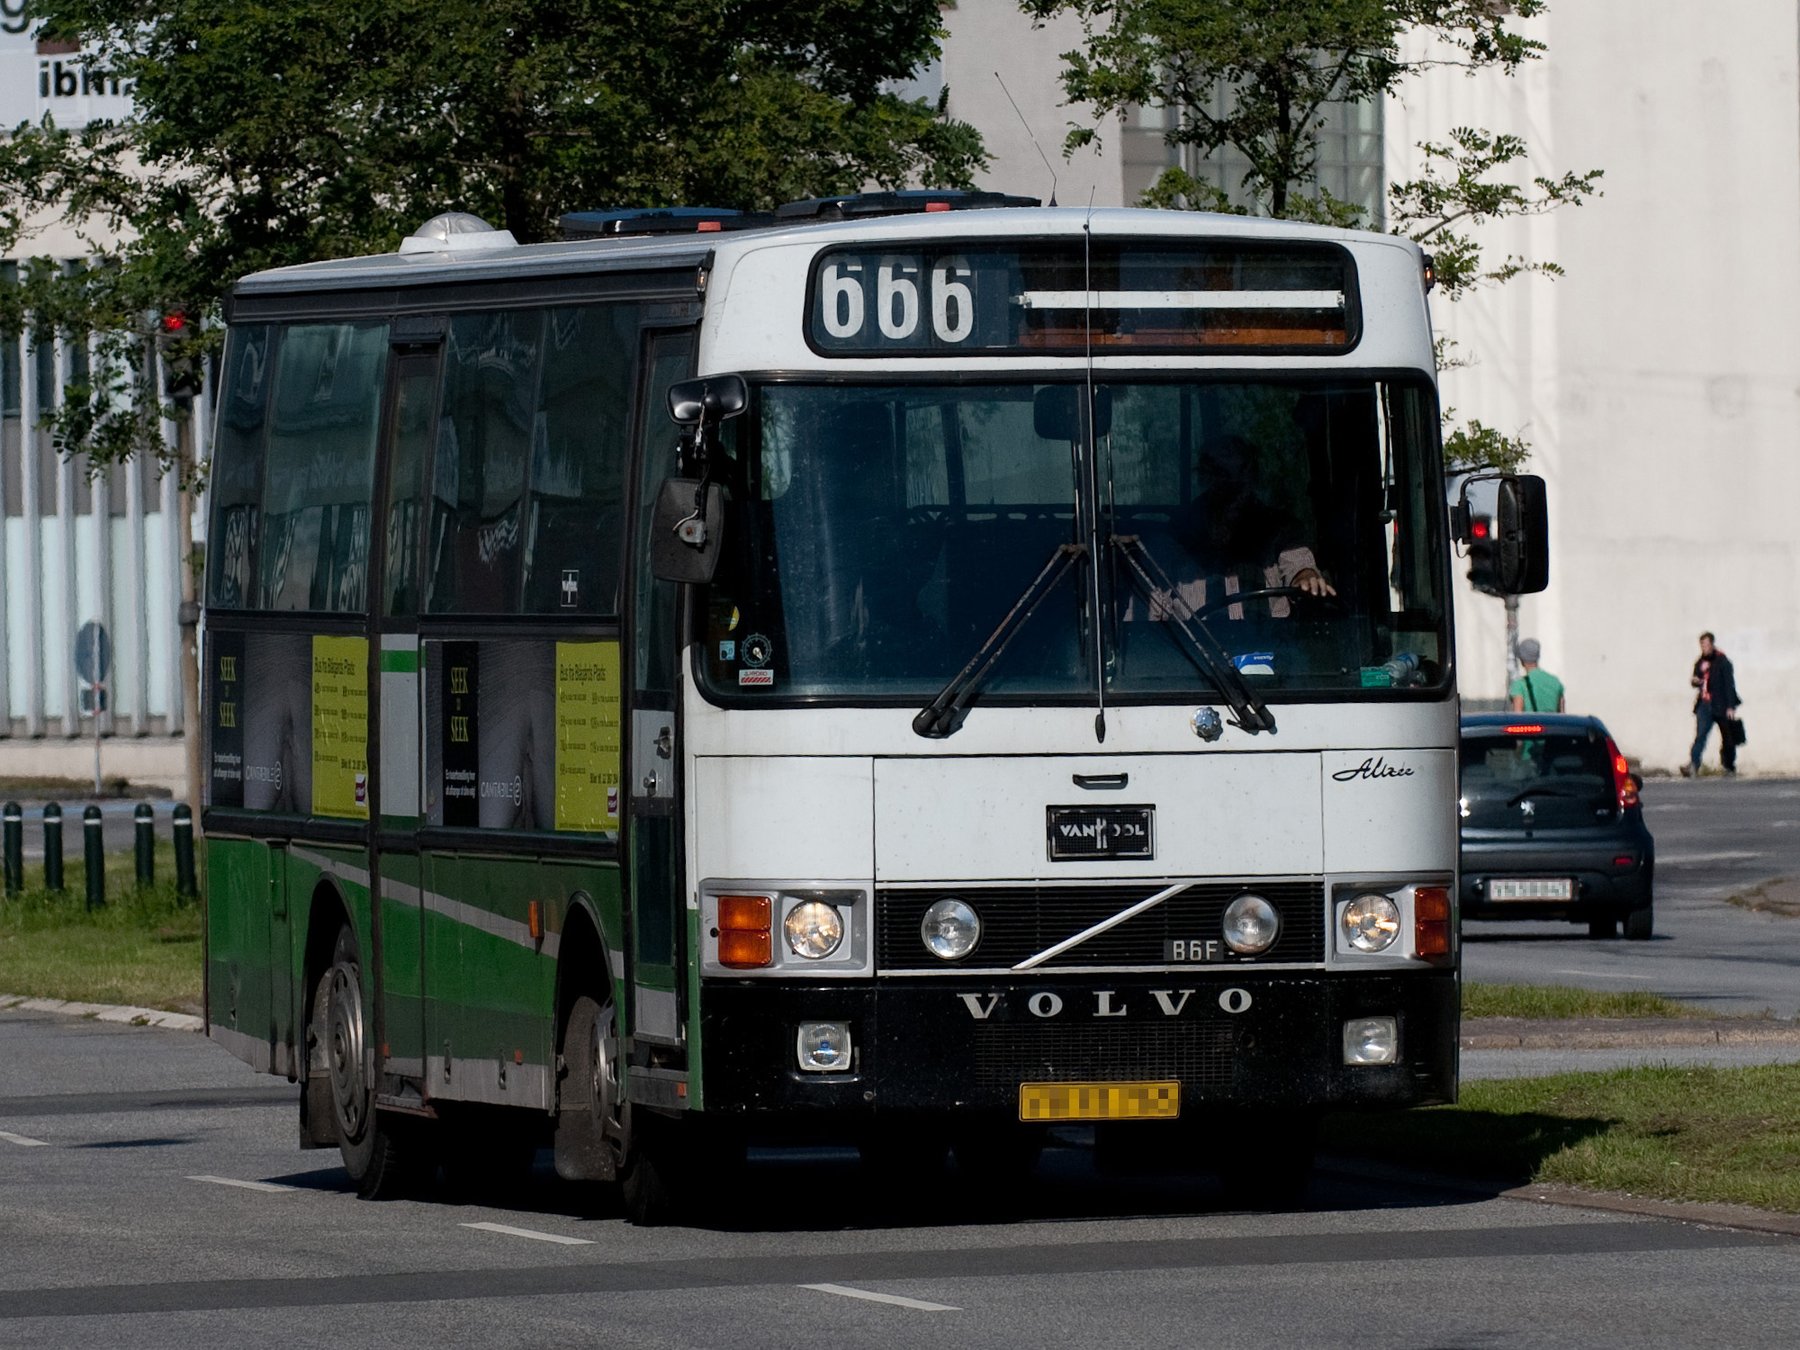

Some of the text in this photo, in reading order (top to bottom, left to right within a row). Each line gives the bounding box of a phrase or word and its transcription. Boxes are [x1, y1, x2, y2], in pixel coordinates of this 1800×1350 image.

[821, 255, 974, 343] 666
[450, 666, 469, 694] SEEK
[450, 716, 469, 742] SEEK
[1173, 939, 1218, 961] B6F
[957, 987, 1253, 1019] VOLVO
